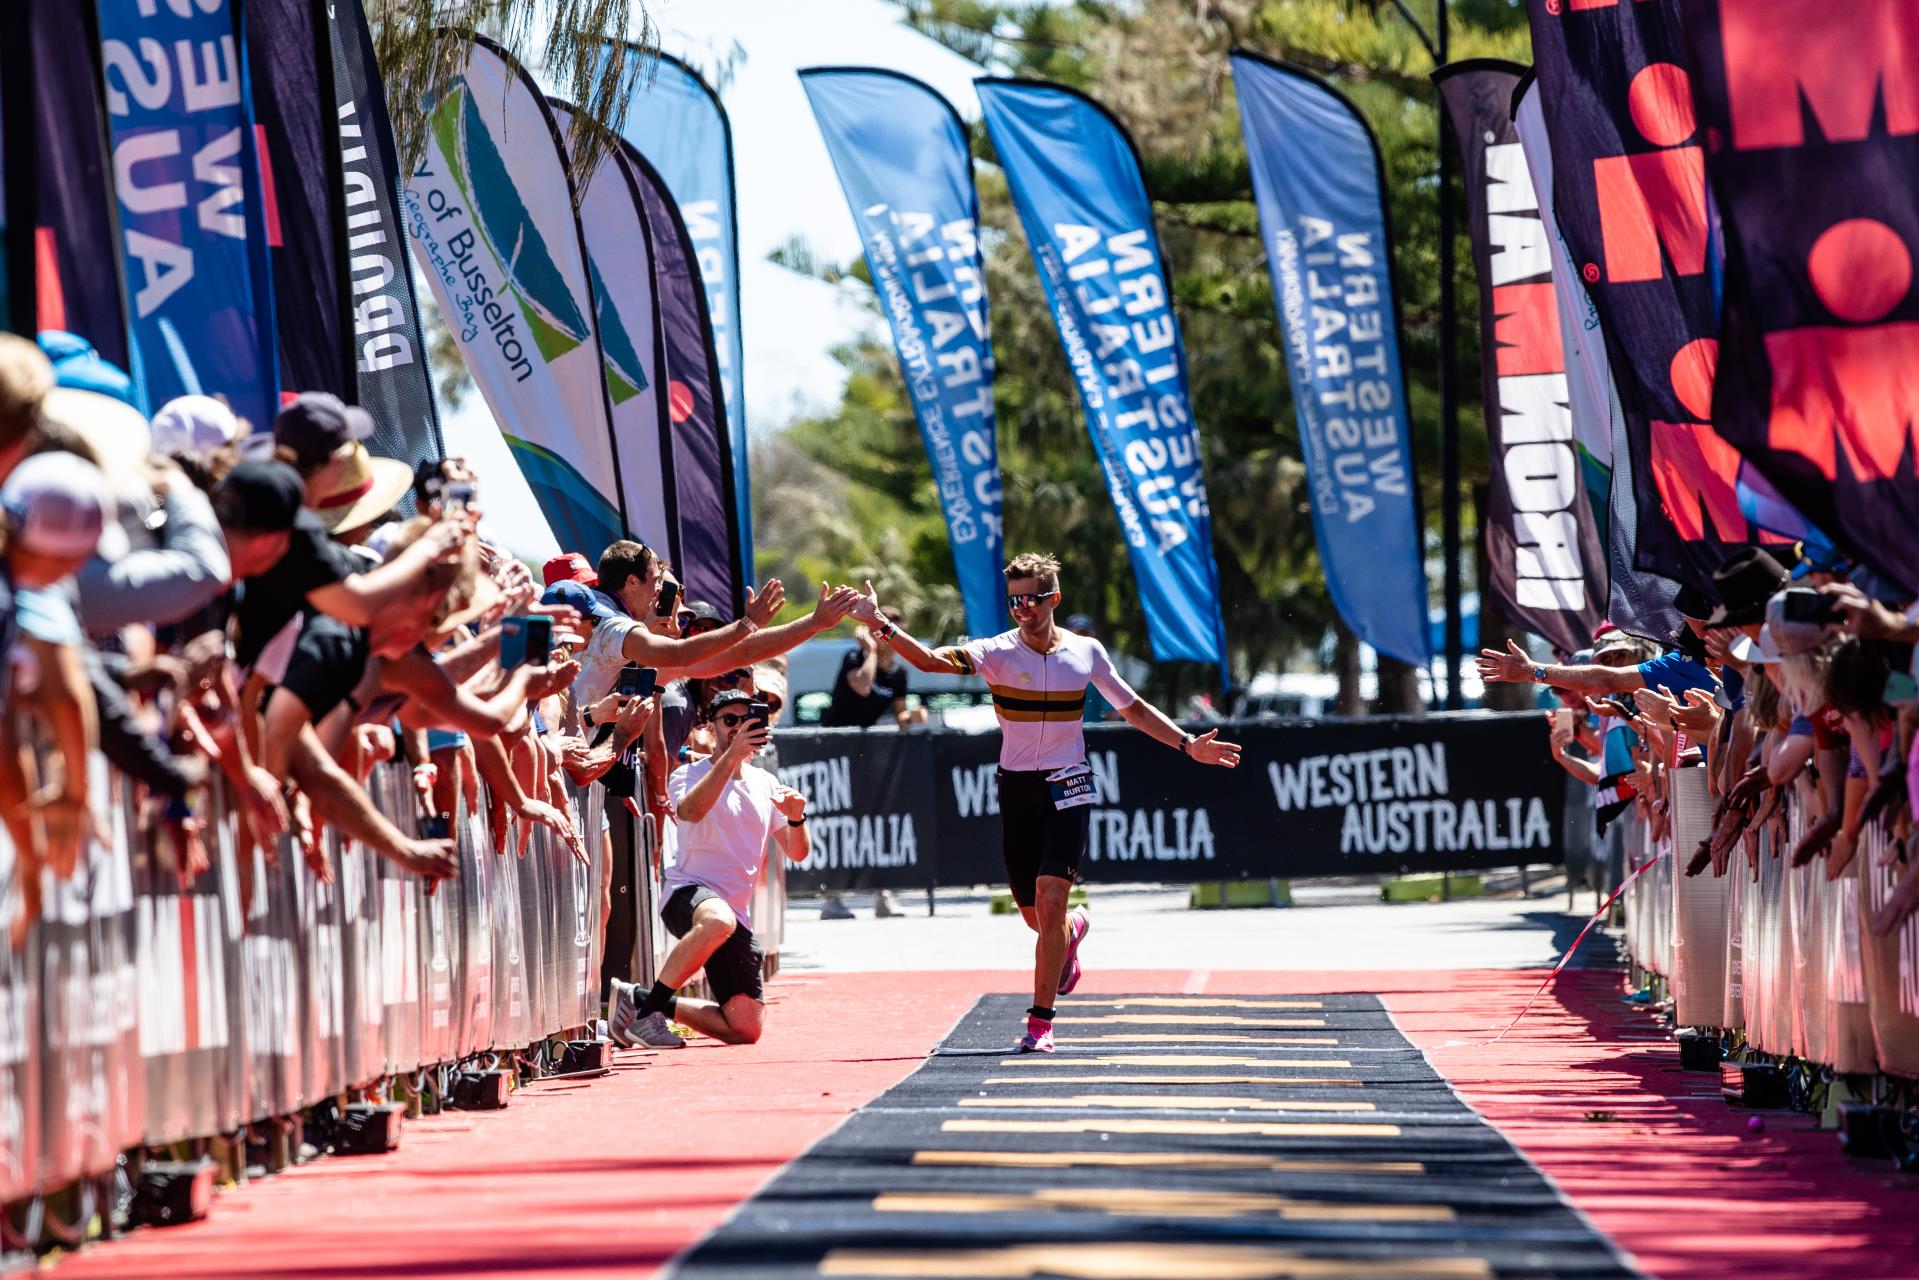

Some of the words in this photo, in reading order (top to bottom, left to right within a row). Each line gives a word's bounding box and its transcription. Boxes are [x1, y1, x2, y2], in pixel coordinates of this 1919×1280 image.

[403, 189, 457, 287] Geographe
[455, 293, 479, 343] Bay
[428, 188, 463, 223] of
[446, 227, 533, 383] Busselton
[778, 755, 853, 816] TERN
[1066, 776, 1086, 788] MATT
[1267, 741, 1449, 811] WESTERN
[785, 812, 918, 872] STRALIA
[1088, 806, 1216, 862] TRALIA
[1340, 797, 1552, 854] AUSTRALIA
